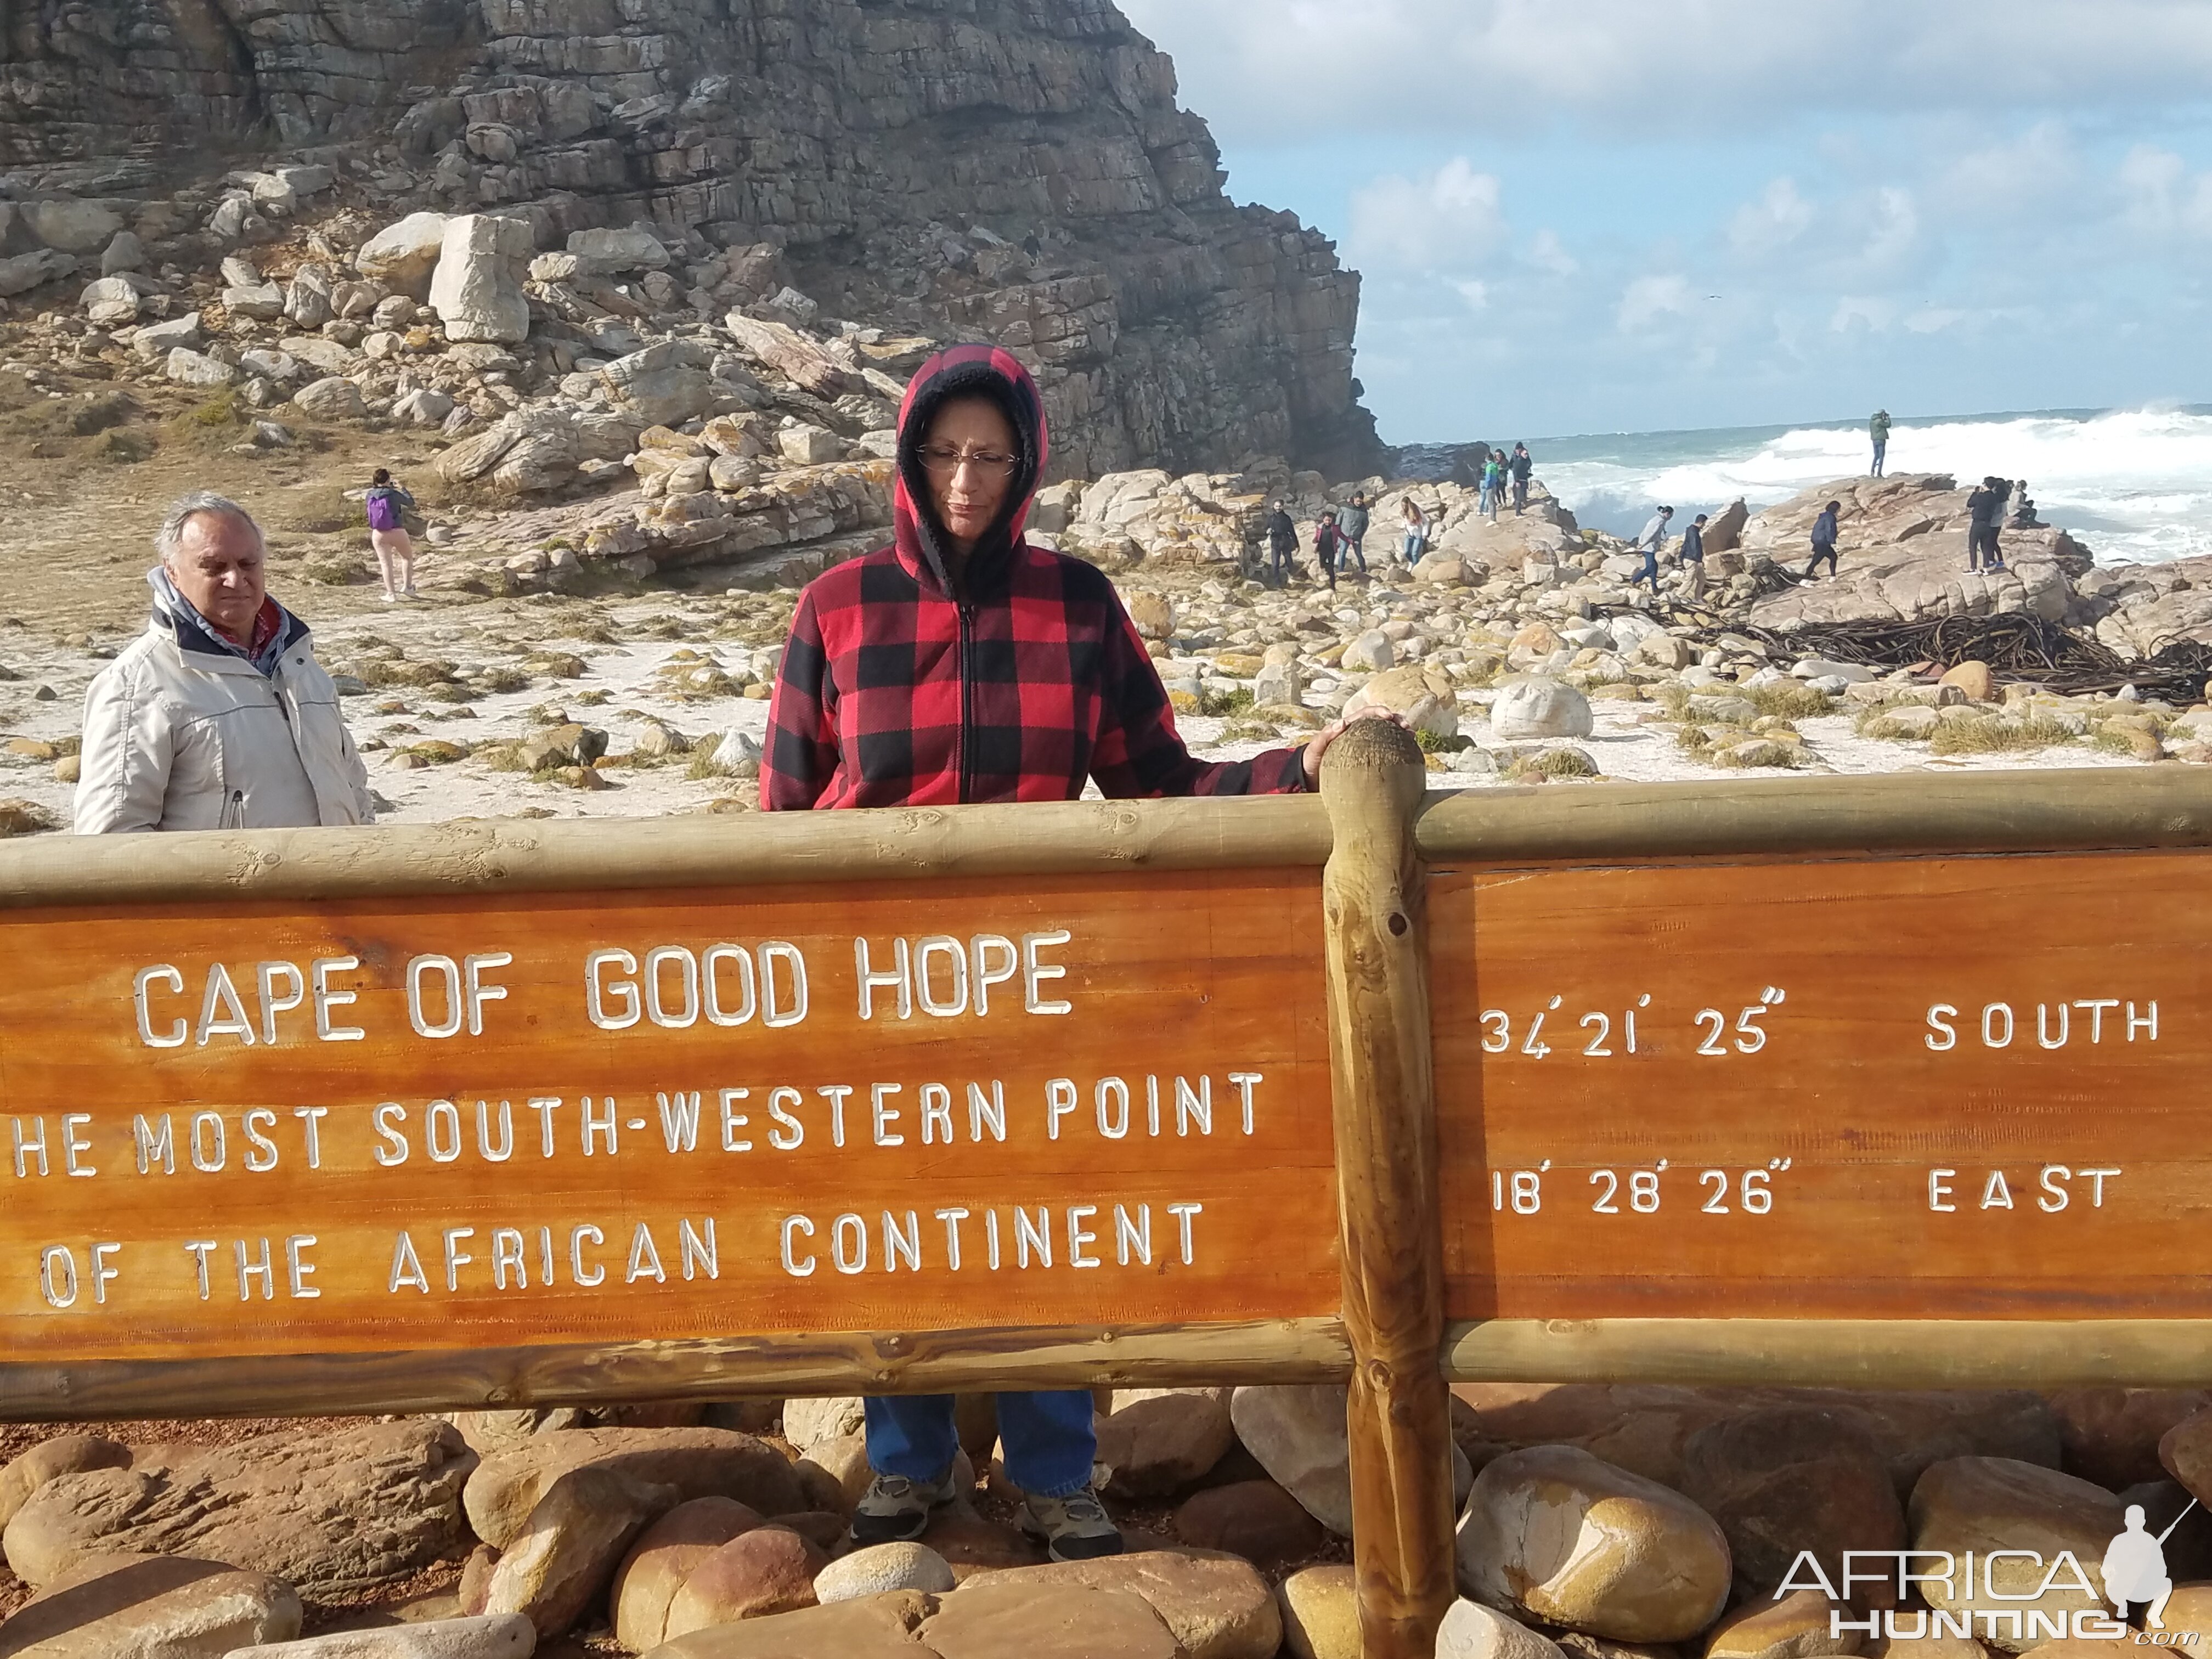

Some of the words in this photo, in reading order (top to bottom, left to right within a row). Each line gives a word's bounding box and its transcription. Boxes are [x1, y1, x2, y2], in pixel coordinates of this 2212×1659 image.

[134, 956, 365, 1047] CAPE
[406, 953, 512, 1037] OF
[585, 941, 808, 1029] GOOD
[855, 930, 1071, 1020] HOPE
[1925, 1000, 2158, 1050] SOUTH
[13, 1114, 96, 1177] HE
[134, 1107, 328, 1174] MOST
[373, 1080, 1006, 1166] SOUTH-WESTERN
[1046, 1073, 1262, 1139] POINT
[1929, 1166, 2121, 1212] EAST
[41, 1243, 121, 1307] OF
[185, 1235, 320, 1301] THE
[390, 1218, 718, 1293] AFRICAN
[781, 1204, 1202, 1276] CONTINENT
